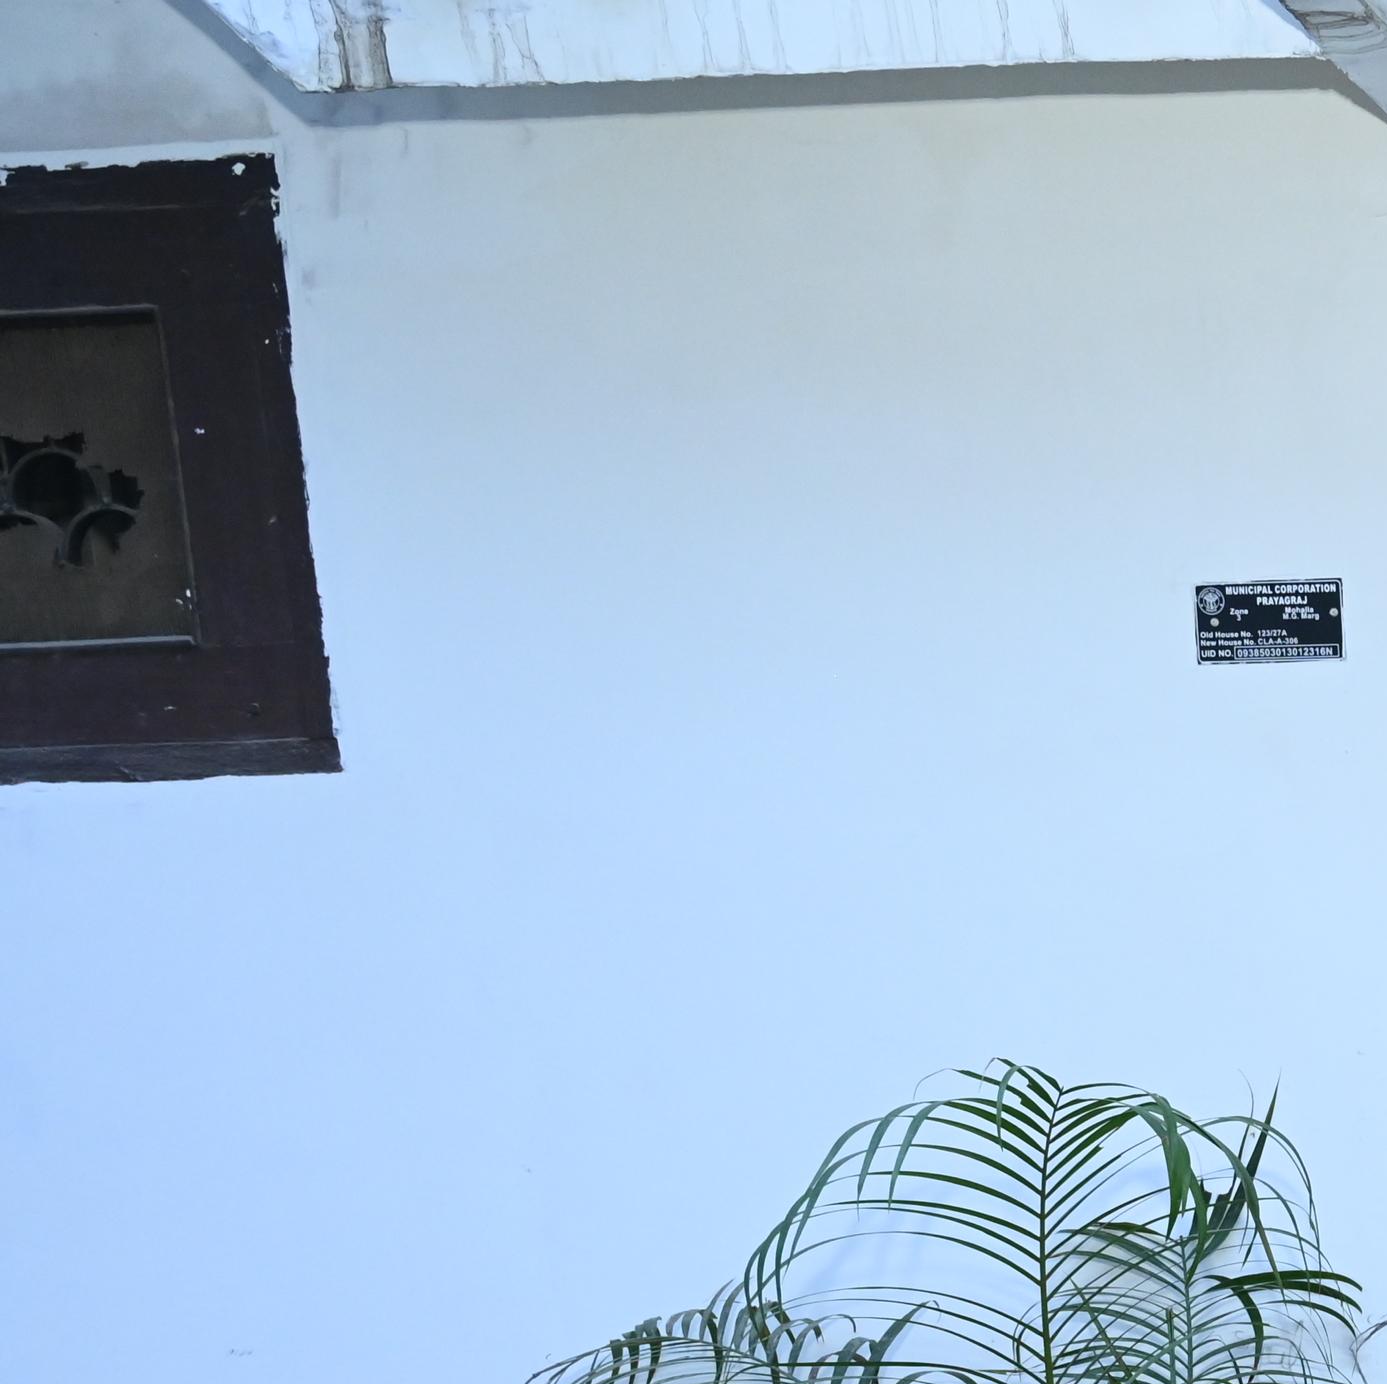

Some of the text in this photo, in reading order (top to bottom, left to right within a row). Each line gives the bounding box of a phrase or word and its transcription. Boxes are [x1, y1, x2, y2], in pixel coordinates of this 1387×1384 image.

[1225, 585, 1273, 595] MUNICIPAL
[1275, 584, 1336, 594] CORPORATION
[1256, 595, 1307, 606] PRAYAGRAJ
[1230, 607, 1249, 615] Zone
[1284, 606, 1314, 614] Mohalla
[1301, 613, 1320, 621] Marg
[1200, 631, 1213, 639] Old
[1240, 630, 1253, 638] No.
[1201, 650, 1216, 658] UID
[1218, 649, 1234, 658] NO.
